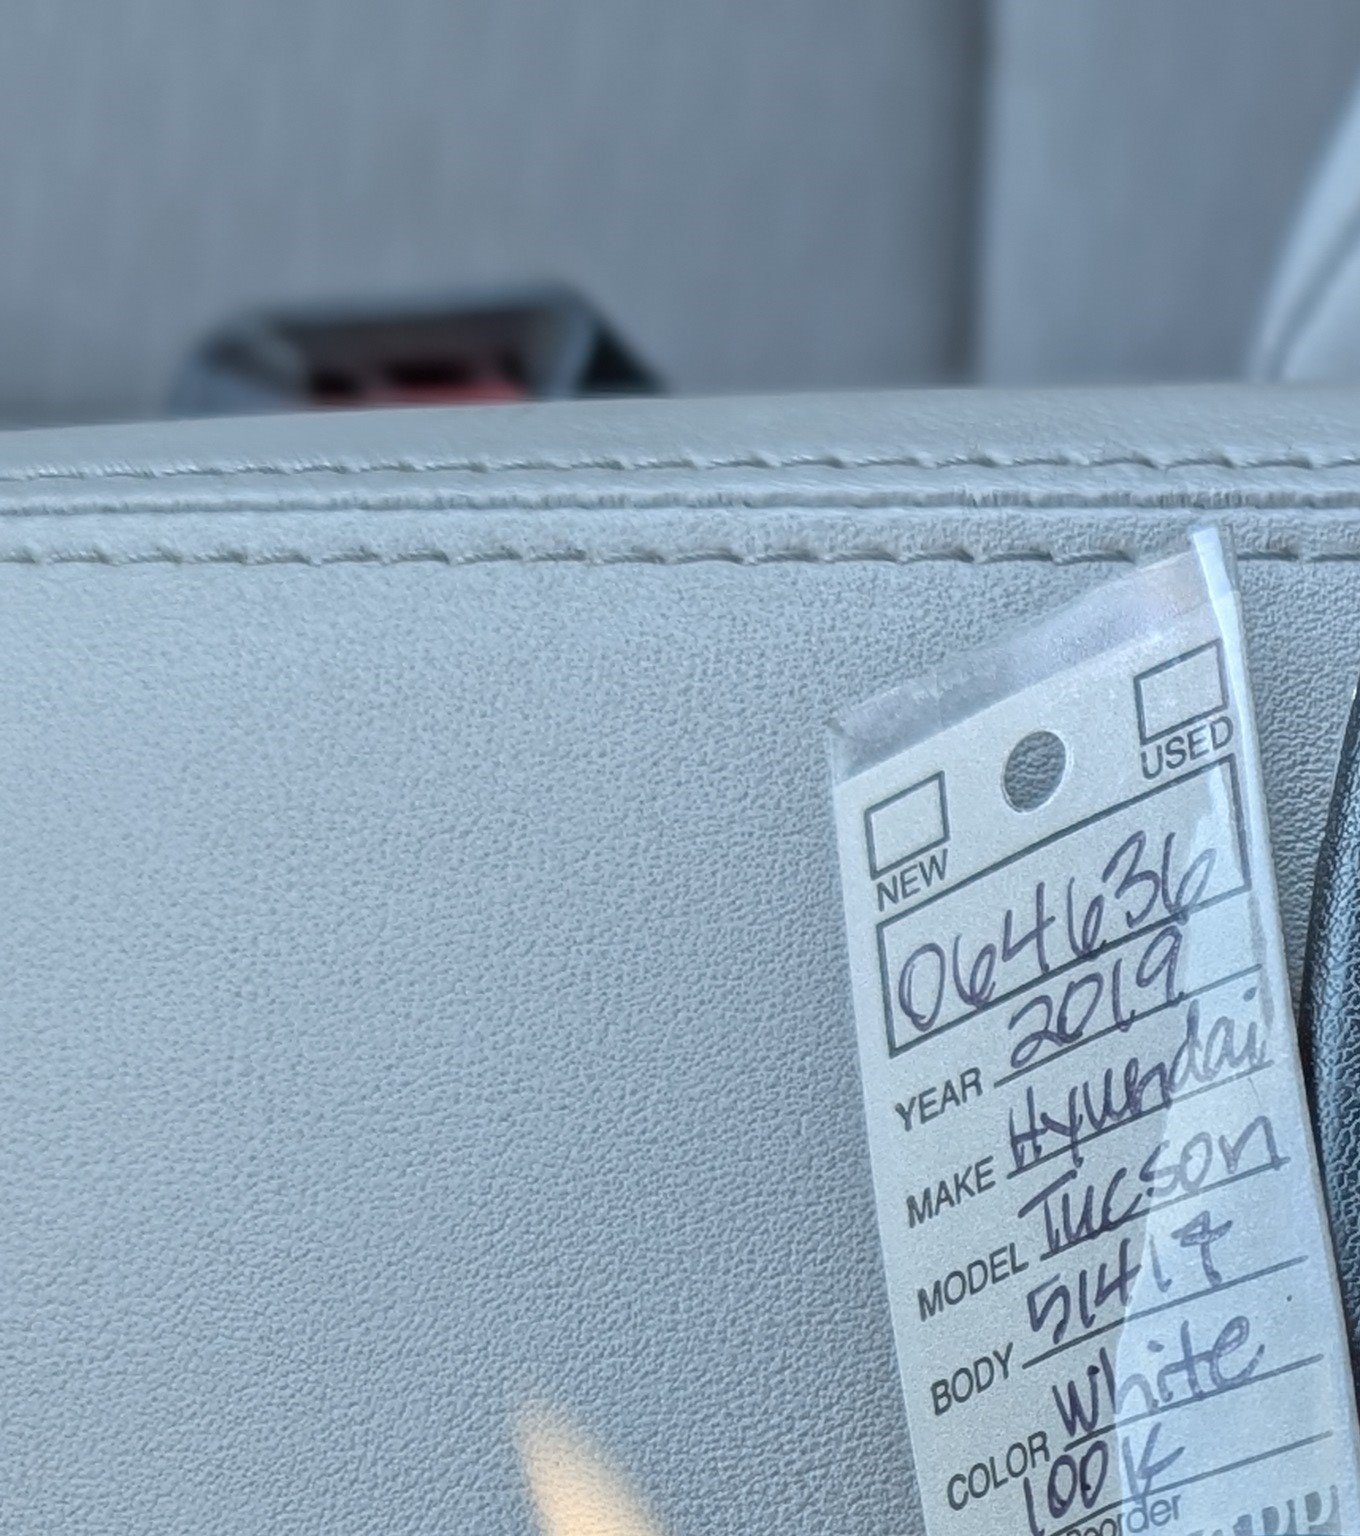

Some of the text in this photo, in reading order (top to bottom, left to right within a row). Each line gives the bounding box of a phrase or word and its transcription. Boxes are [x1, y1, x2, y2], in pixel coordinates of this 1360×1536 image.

[1140, 715, 1234, 780] USED
[876, 850, 949, 911] NEW
[899, 829, 1215, 1031] 064636
[1008, 926, 1186, 1069] 2019
[894, 1066, 983, 1130] YEAR
[1009, 987, 1267, 1169] Hyundai
[906, 1163, 998, 1228] MAKE
[1018, 1115, 1282, 1252] Tucson
[917, 1242, 1030, 1321] MODEL
[1027, 1209, 1233, 1344] 51417
[930, 1342, 1016, 1417] BODY
[1051, 1315, 1265, 1436] White
[947, 1430, 1050, 1511] COLOR
